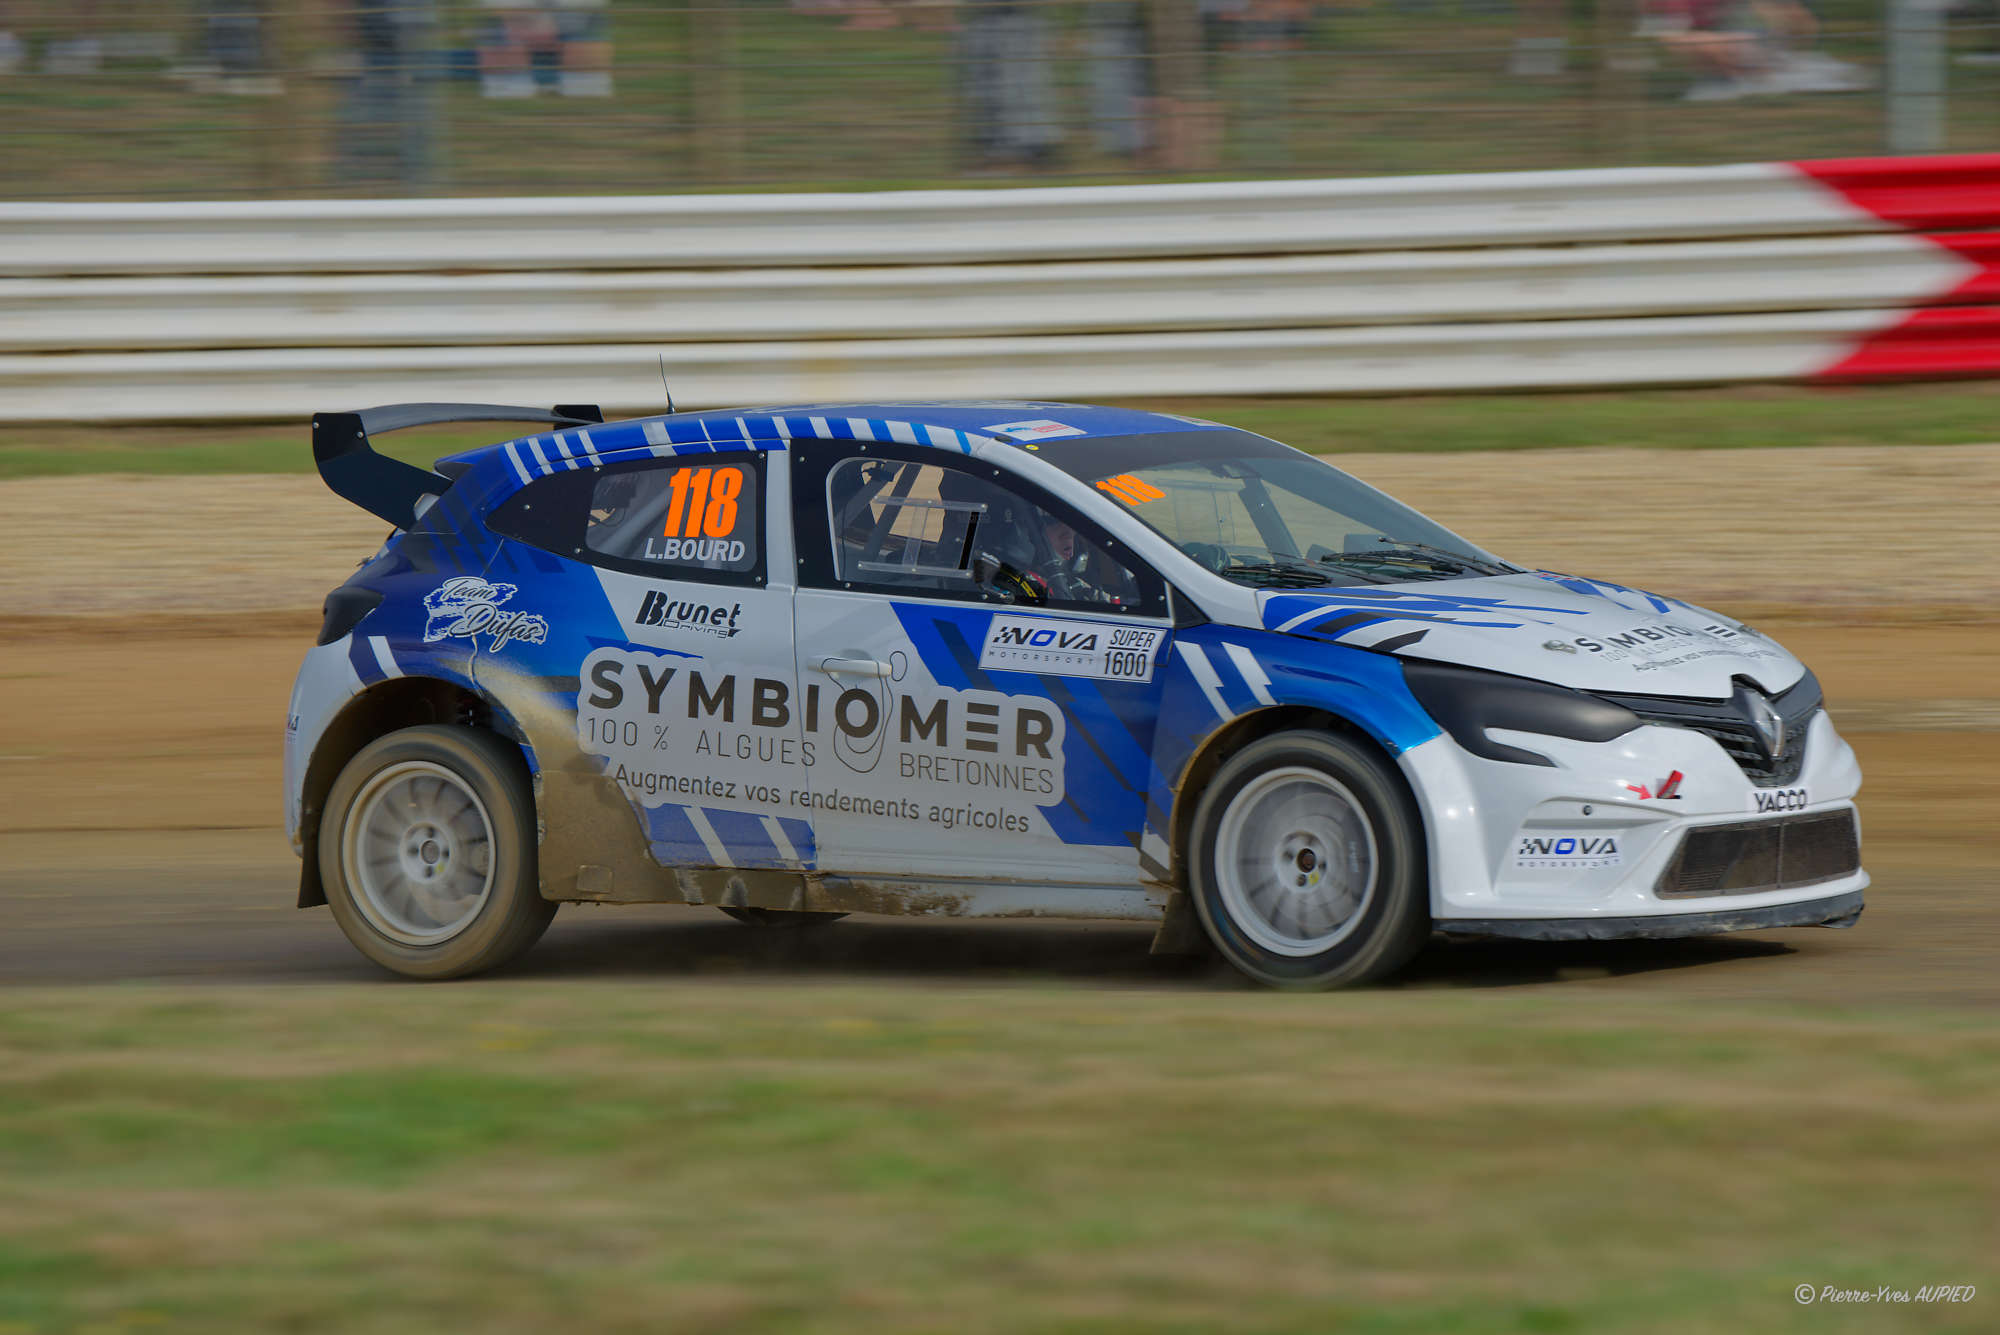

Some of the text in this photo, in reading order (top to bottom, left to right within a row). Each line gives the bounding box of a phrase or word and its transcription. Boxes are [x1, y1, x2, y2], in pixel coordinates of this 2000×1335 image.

[664, 467, 743, 538] 118
[1096, 474, 1166, 506] 118
[644, 538, 746, 562] L.BOURD
[441, 577, 496, 600] Team
[635, 590, 741, 628] Brunet
[663, 620, 730, 639] Driving
[992, 626, 1099, 651] NOVA
[1110, 629, 1156, 648] SUPER
[1574, 625, 1737, 653] SMBIOE
[1104, 651, 1147, 677] 1600
[588, 660, 1054, 760] SYMBIOMER
[588, 718, 1054, 794] 100 % ALGUES BRETONNES
[616, 764, 1029, 833] Augmentez vos rendements agricoles
[1754, 789, 1807, 813] YACCO
[1519, 838, 1617, 854] NOVA
